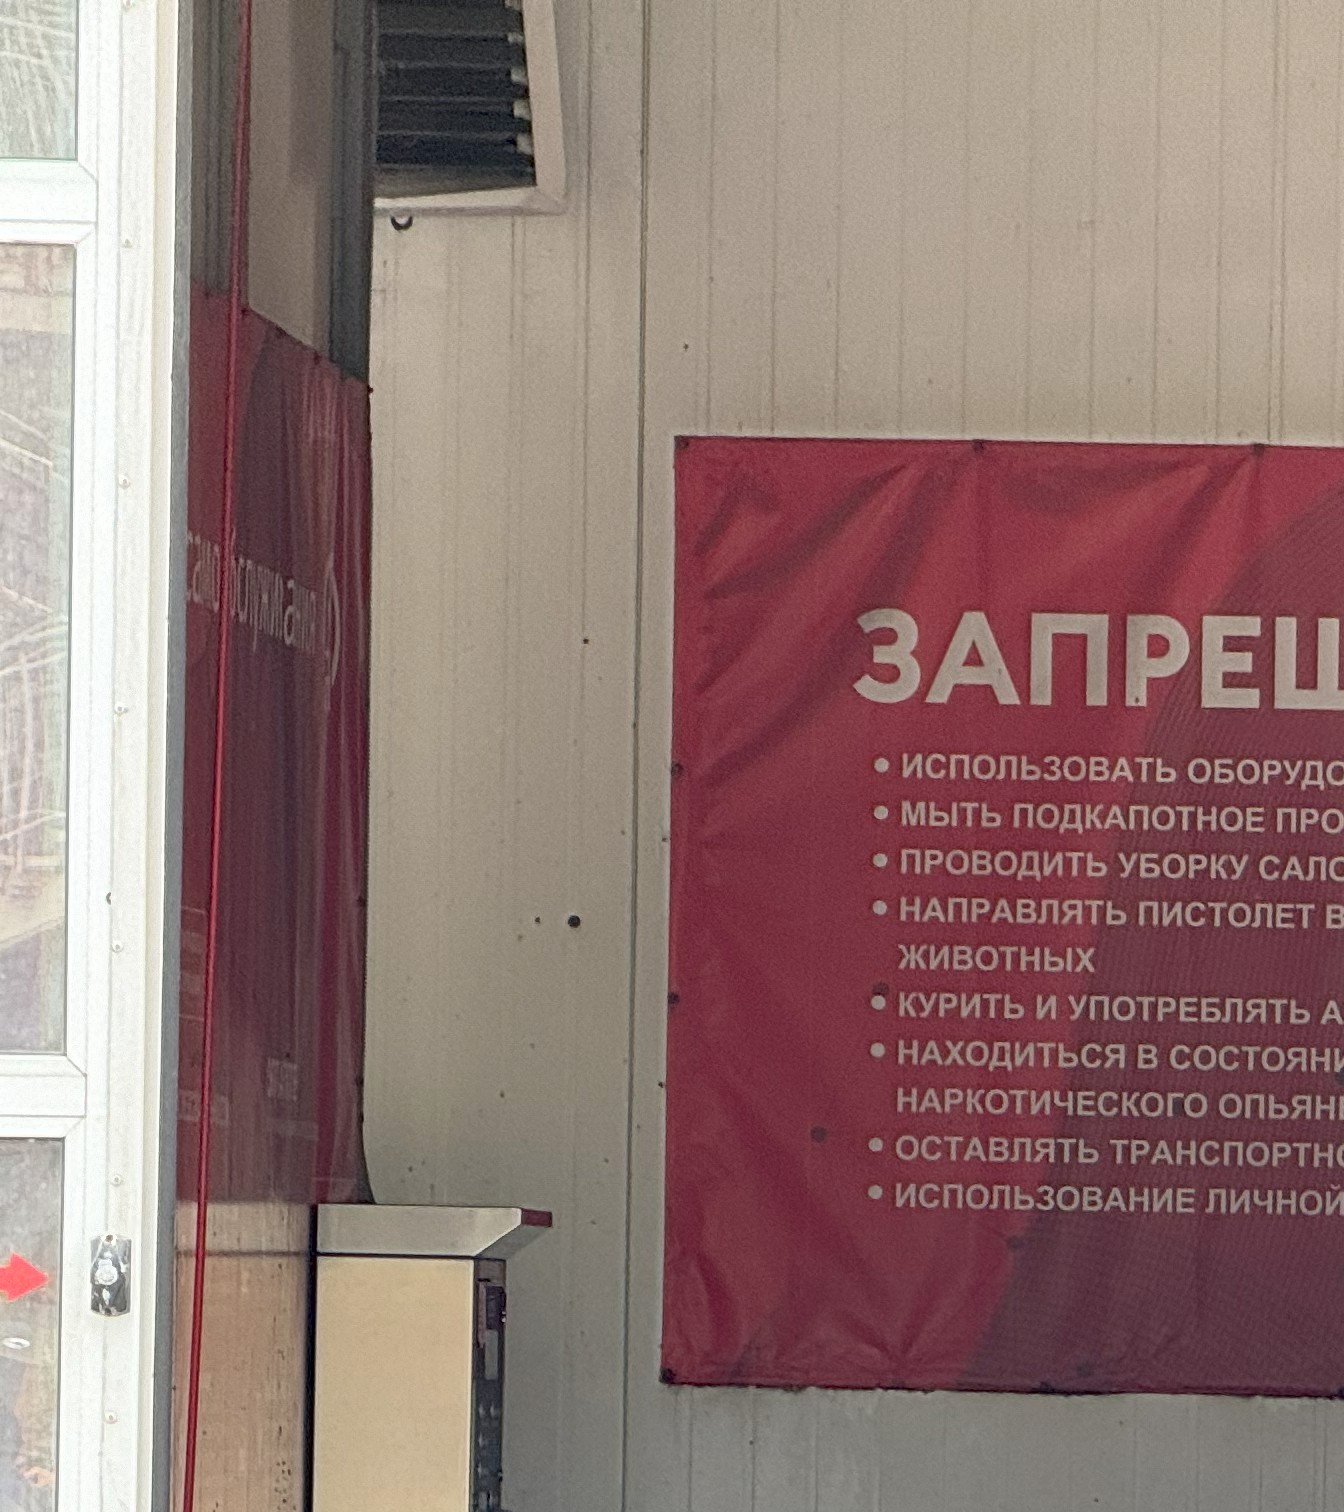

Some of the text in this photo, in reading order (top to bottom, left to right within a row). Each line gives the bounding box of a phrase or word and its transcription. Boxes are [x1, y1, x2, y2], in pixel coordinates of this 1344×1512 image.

[902, 753, 1177, 783] ИСПОЛЬЗОВАТЬ
[901, 800, 1002, 828] МЫТЬ
[1013, 803, 1265, 835] ПОДКАПОТНОЕ
[900, 848, 1108, 882] ПРОВОДИТЬ
[1118, 852, 1249, 881] УБОРКУ
[899, 896, 1127, 926] НАПРАВЛЯТЬ
[1138, 900, 1316, 929] ПИСТОЛЕТ
[898, 944, 1095, 973] ЖИВОТНЫХ
[898, 991, 1025, 1020] КУРИТЬ
[1036, 994, 1057, 1020] И
[1068, 994, 1311, 1025] УПОТРЕБЛЯТЬ
[897, 1039, 1126, 1072] НАХОДИТЬСЯ
[1137, 1043, 1159, 1070] В
[897, 1087, 1209, 1119] НАРКОТИЧЕСКОГО
[895, 1134, 1100, 1164] ОСТАВЛЯТЬ
[895, 1182, 1196, 1214] ИСПОЛЬЗОВАНИЕ
